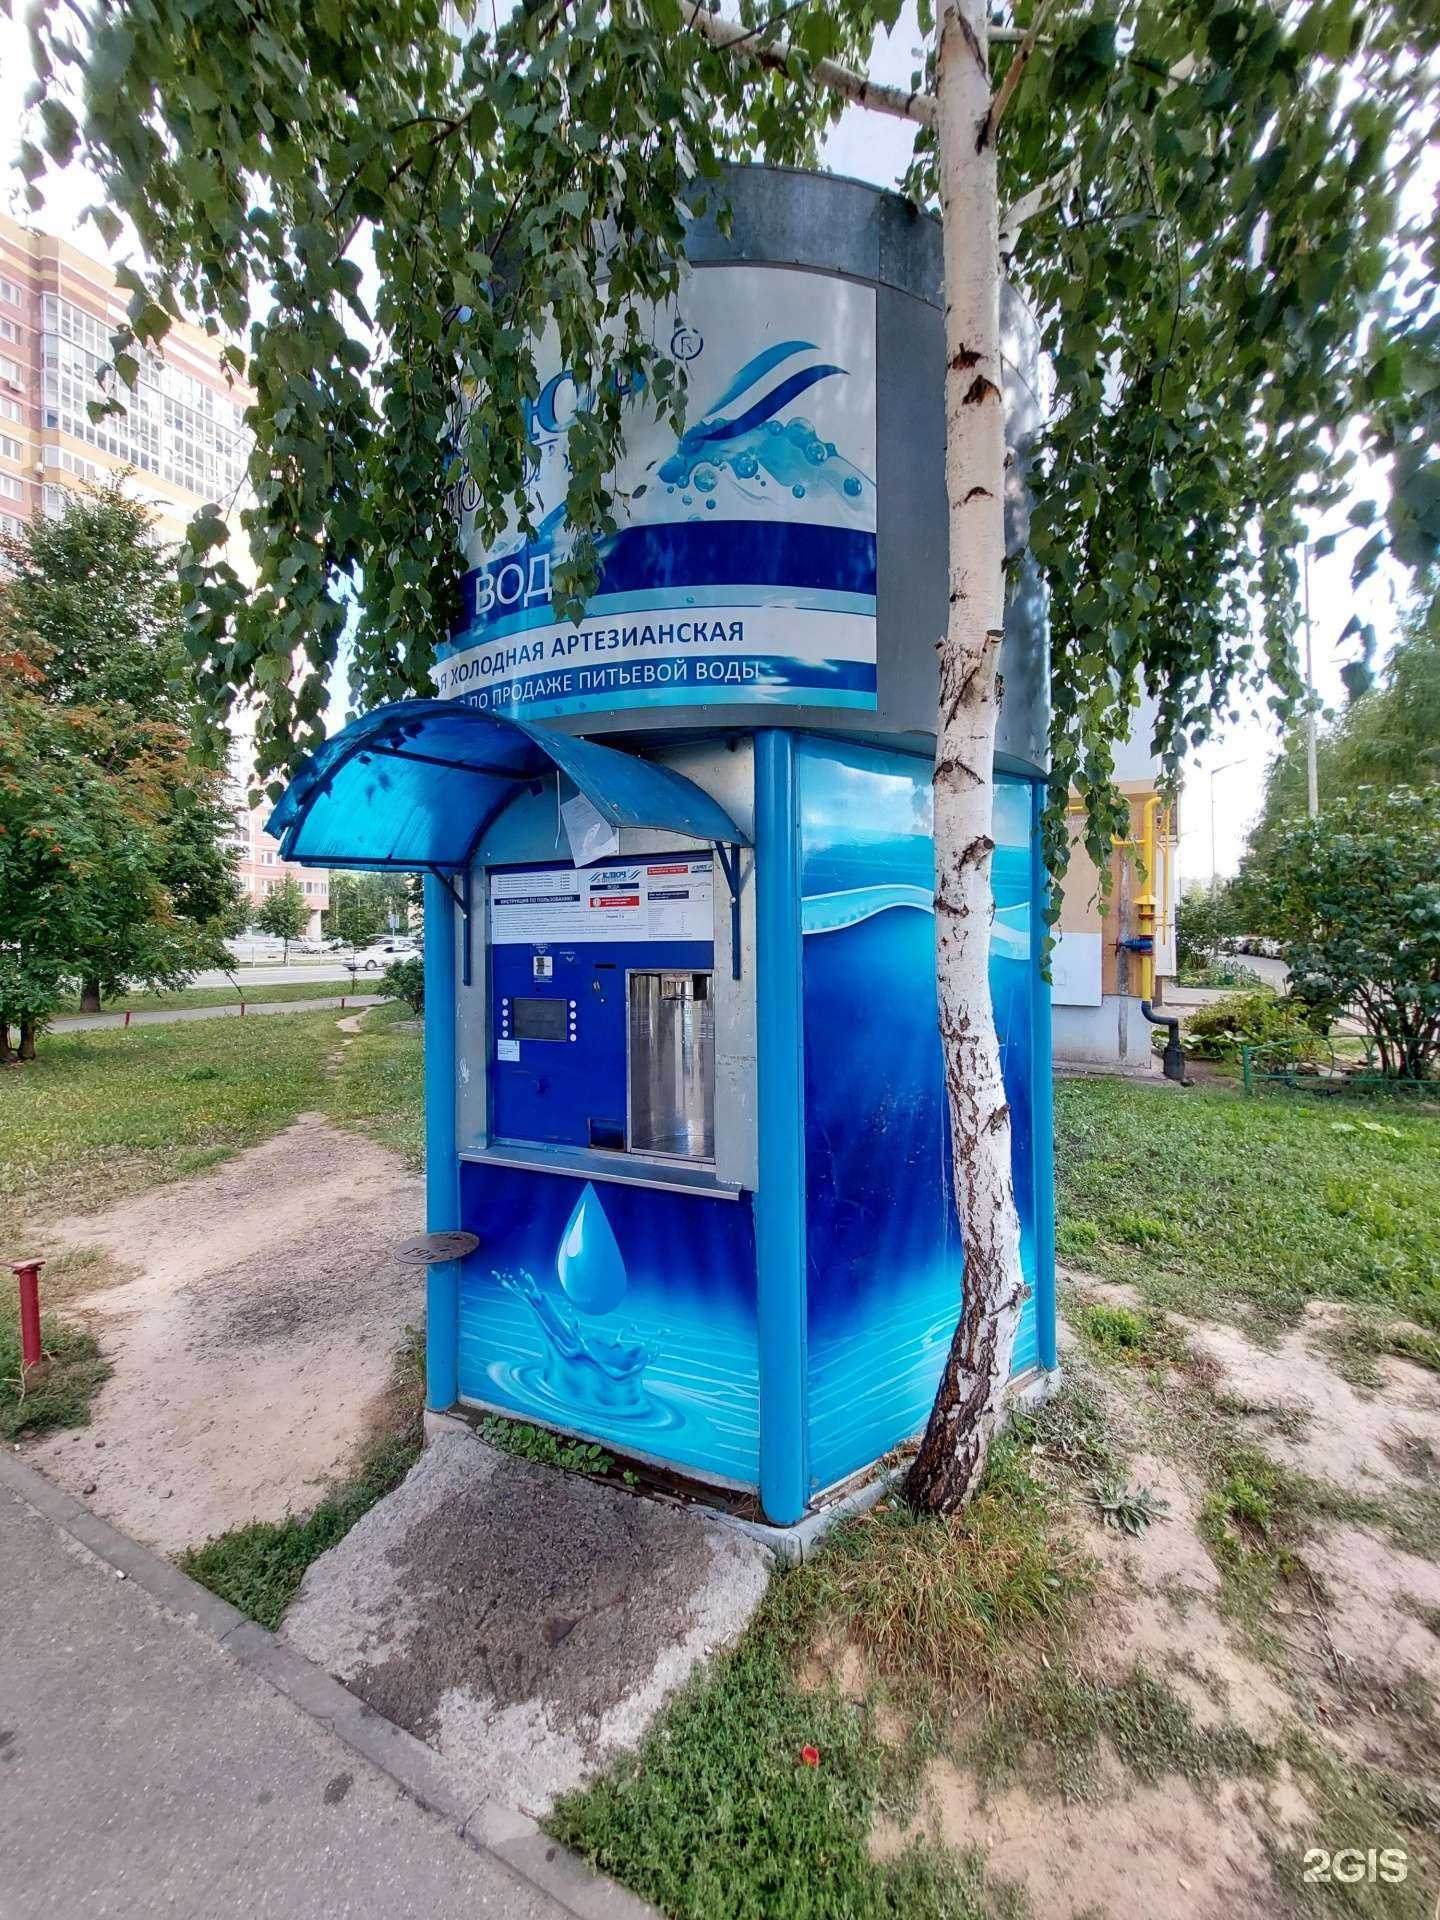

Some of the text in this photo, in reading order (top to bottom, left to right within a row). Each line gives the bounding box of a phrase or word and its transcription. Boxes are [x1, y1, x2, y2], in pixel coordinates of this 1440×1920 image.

[475, 553, 553, 615] ВОД
[450, 641, 544, 686] ХОЛОДНАЯ
[551, 621, 744, 658] АРТЕЗИАНСКАЯ
[469, 658, 760, 709] ПО ПРОДАЖЕ ПИТЬЕВОЙ ВОДЫ
